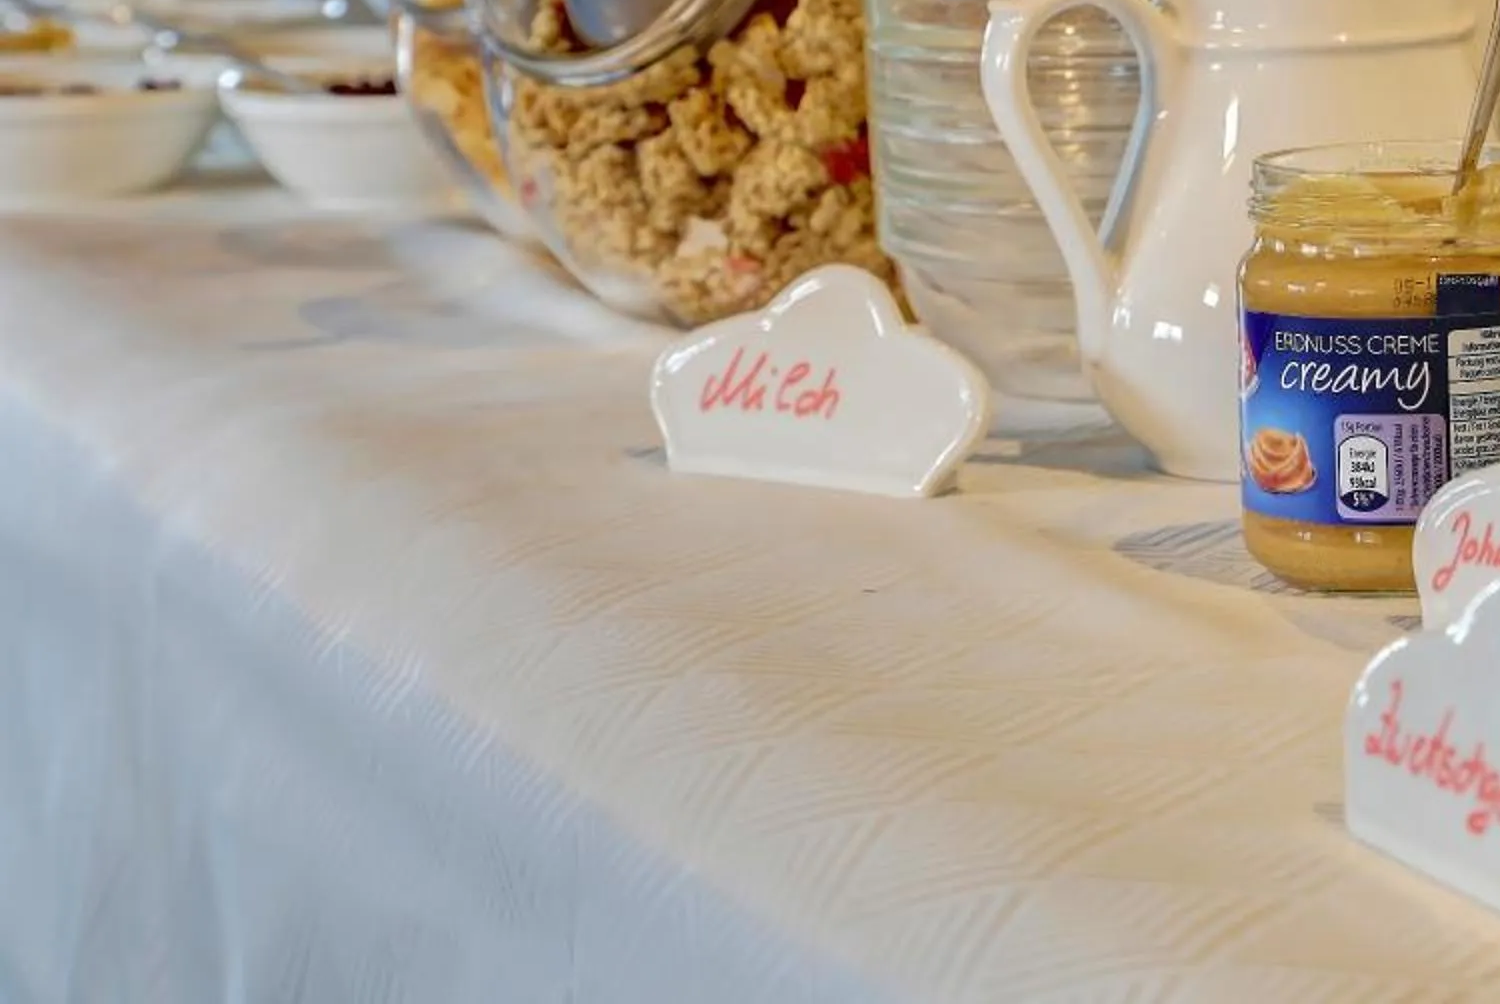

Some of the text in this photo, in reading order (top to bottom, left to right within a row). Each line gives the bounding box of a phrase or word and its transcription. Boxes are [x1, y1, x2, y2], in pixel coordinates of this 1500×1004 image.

[1274, 330, 1363, 356] ERDNUSS
[1367, 332, 1441, 356] CREME
[697, 346, 845, 420] Milch
[1280, 360, 1432, 411] creamy
